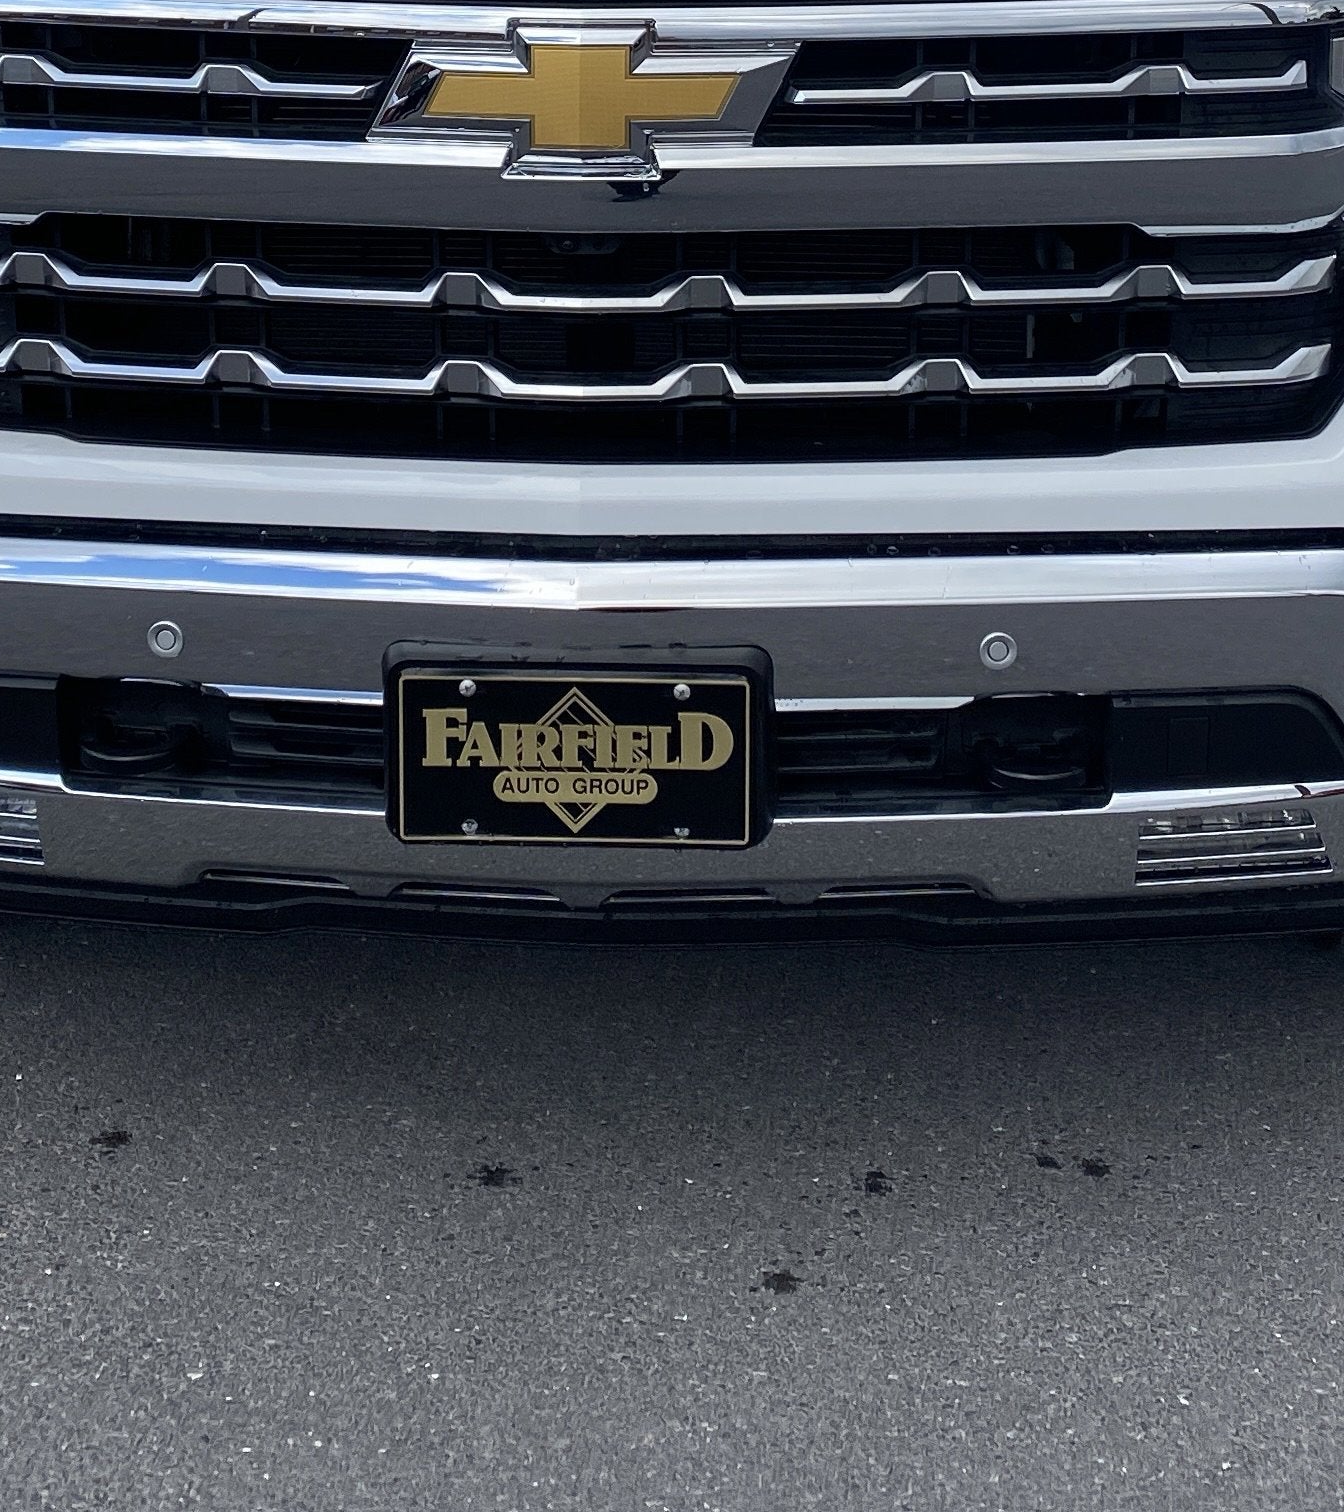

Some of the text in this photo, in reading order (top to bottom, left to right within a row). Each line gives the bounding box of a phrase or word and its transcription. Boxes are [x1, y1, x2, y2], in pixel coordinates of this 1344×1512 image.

[422, 708, 734, 771] FAIRFIELD
[501, 777, 650, 796] AUTO GROUP
